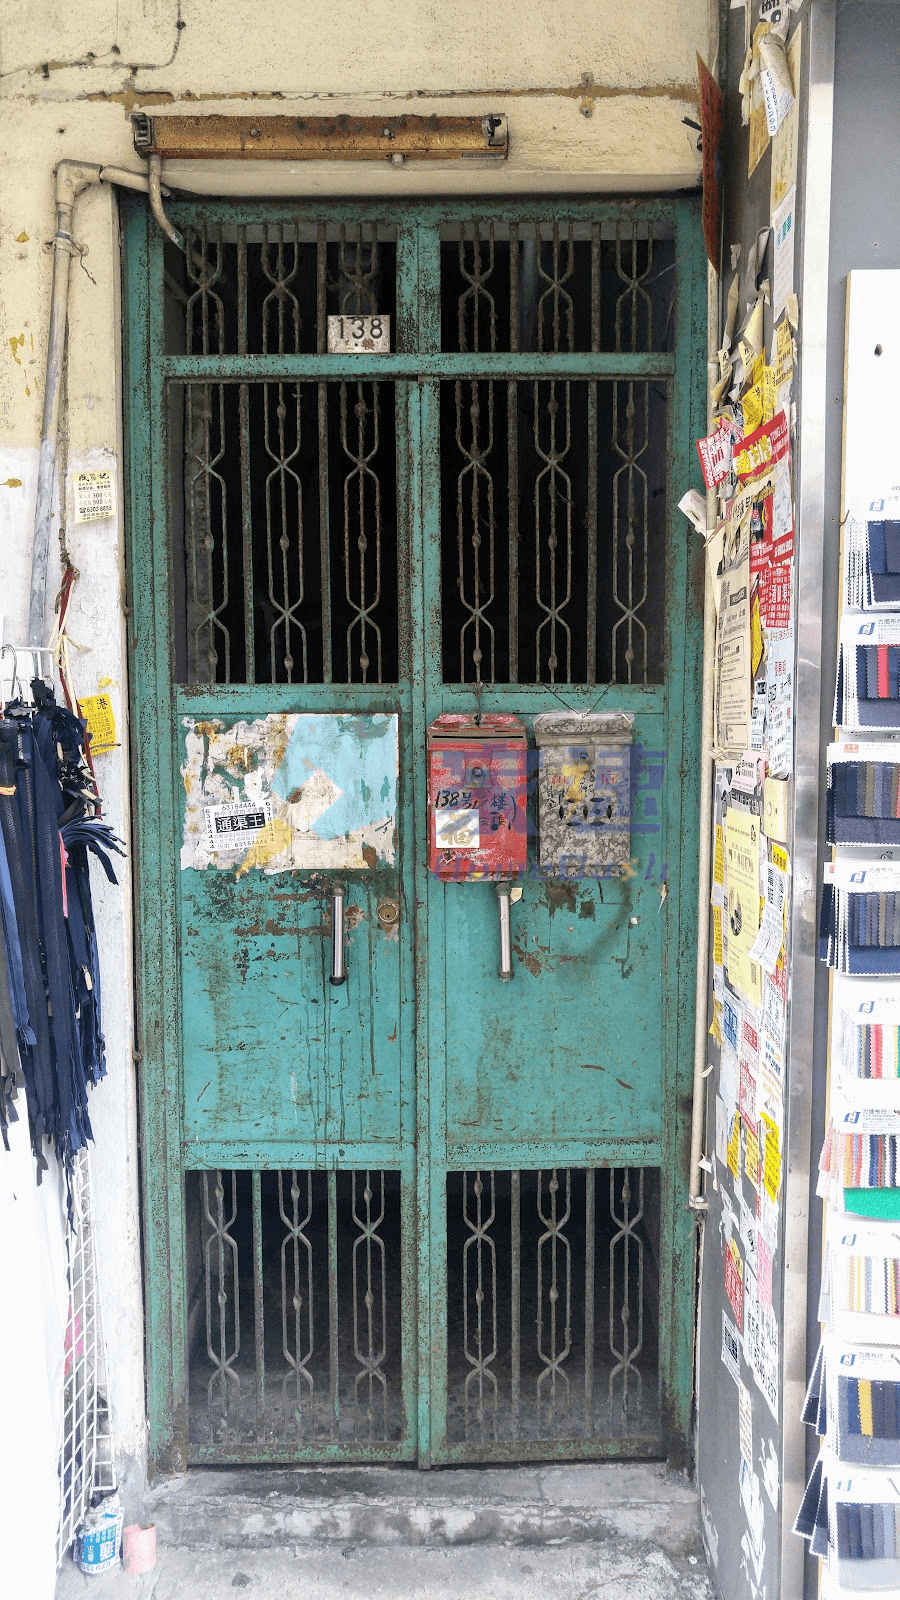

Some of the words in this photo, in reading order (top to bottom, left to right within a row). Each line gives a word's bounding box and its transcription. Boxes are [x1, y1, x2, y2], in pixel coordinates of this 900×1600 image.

[337, 316, 383, 339] 138
[222, 802, 255, 810] 63184444
[215, 813, 265, 832] 通渠王
